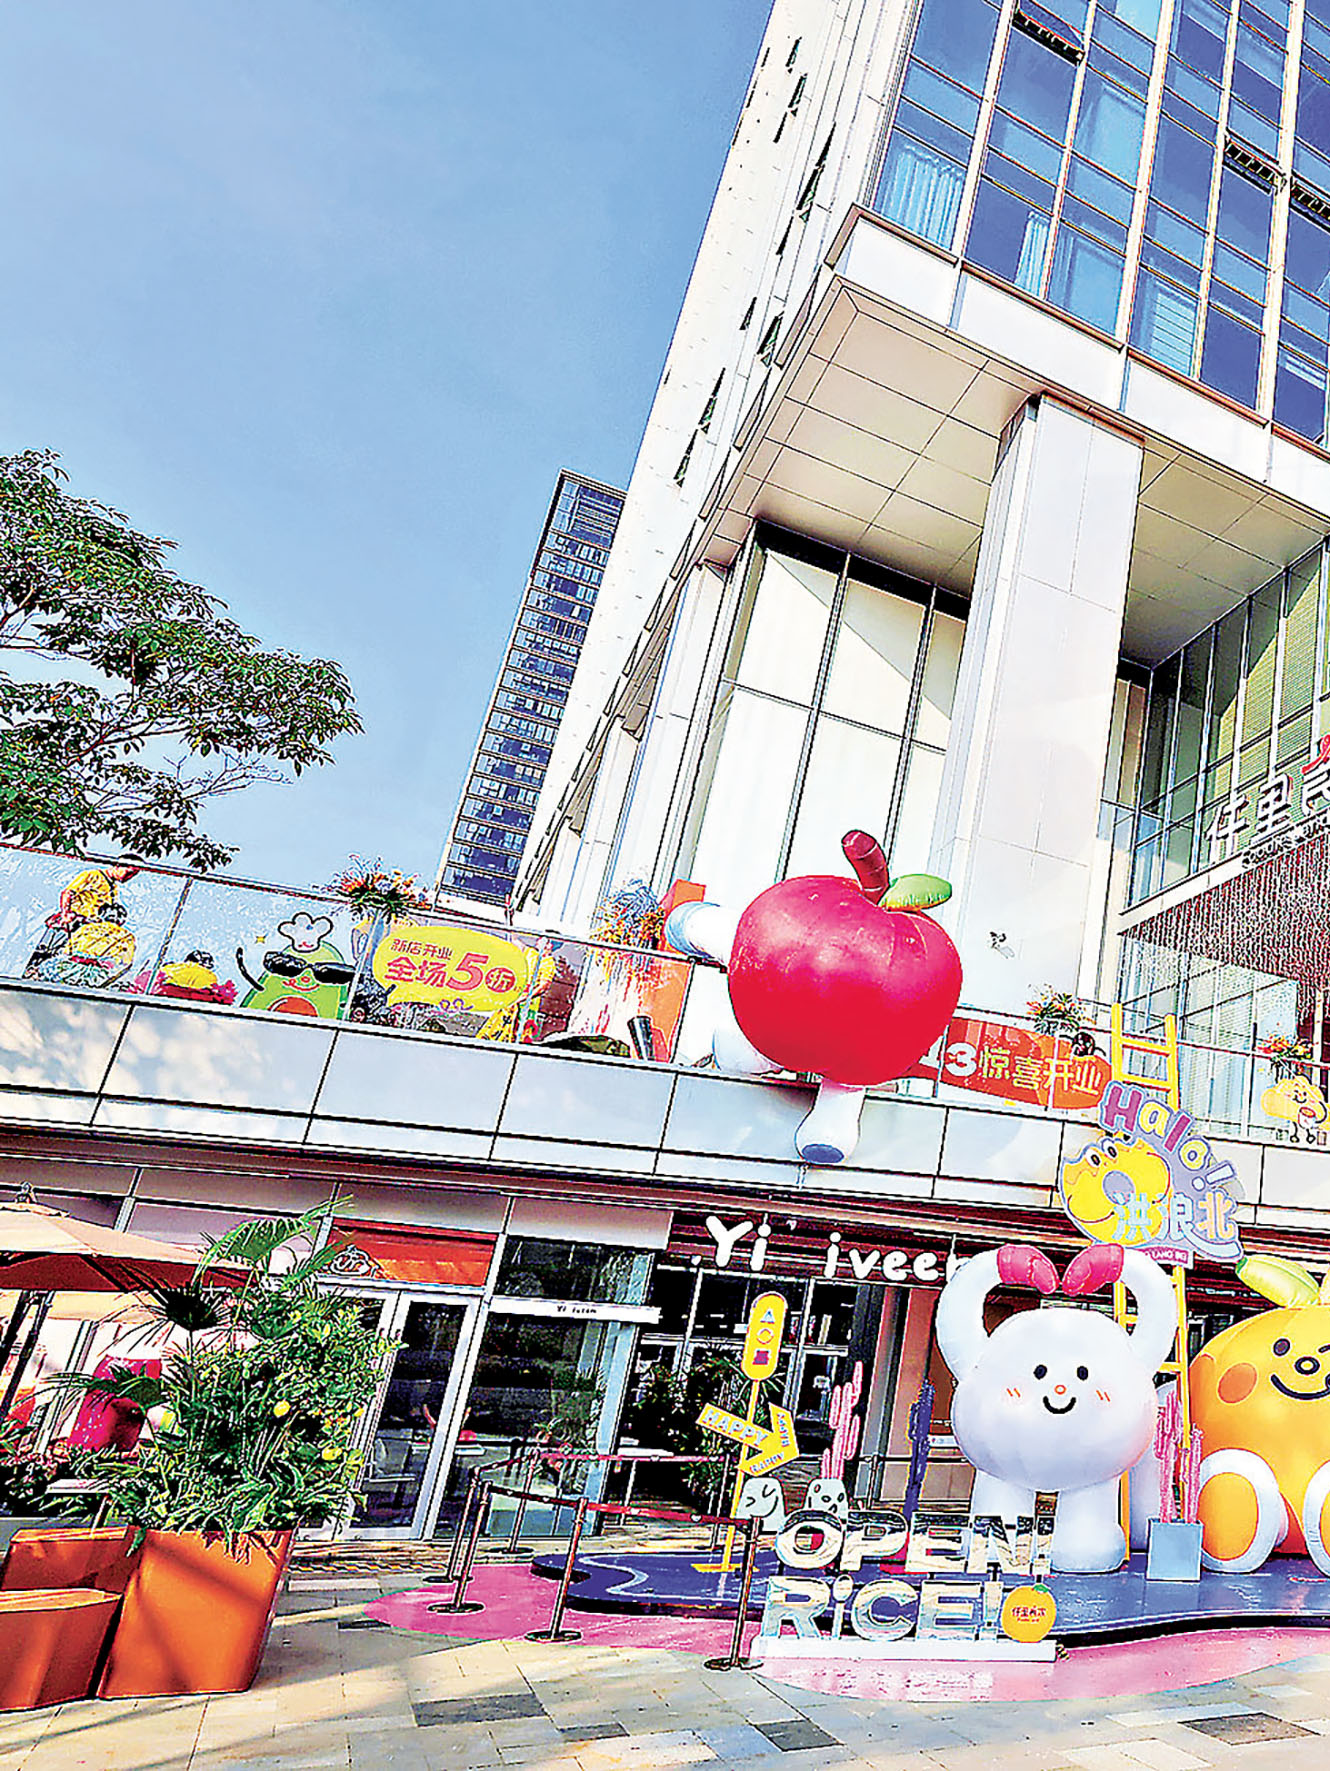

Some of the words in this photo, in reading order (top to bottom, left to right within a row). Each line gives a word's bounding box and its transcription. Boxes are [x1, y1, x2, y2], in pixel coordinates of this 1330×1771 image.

[390, 938, 453, 961] 新店开业
[702, 1409, 768, 1447] HAPPY
